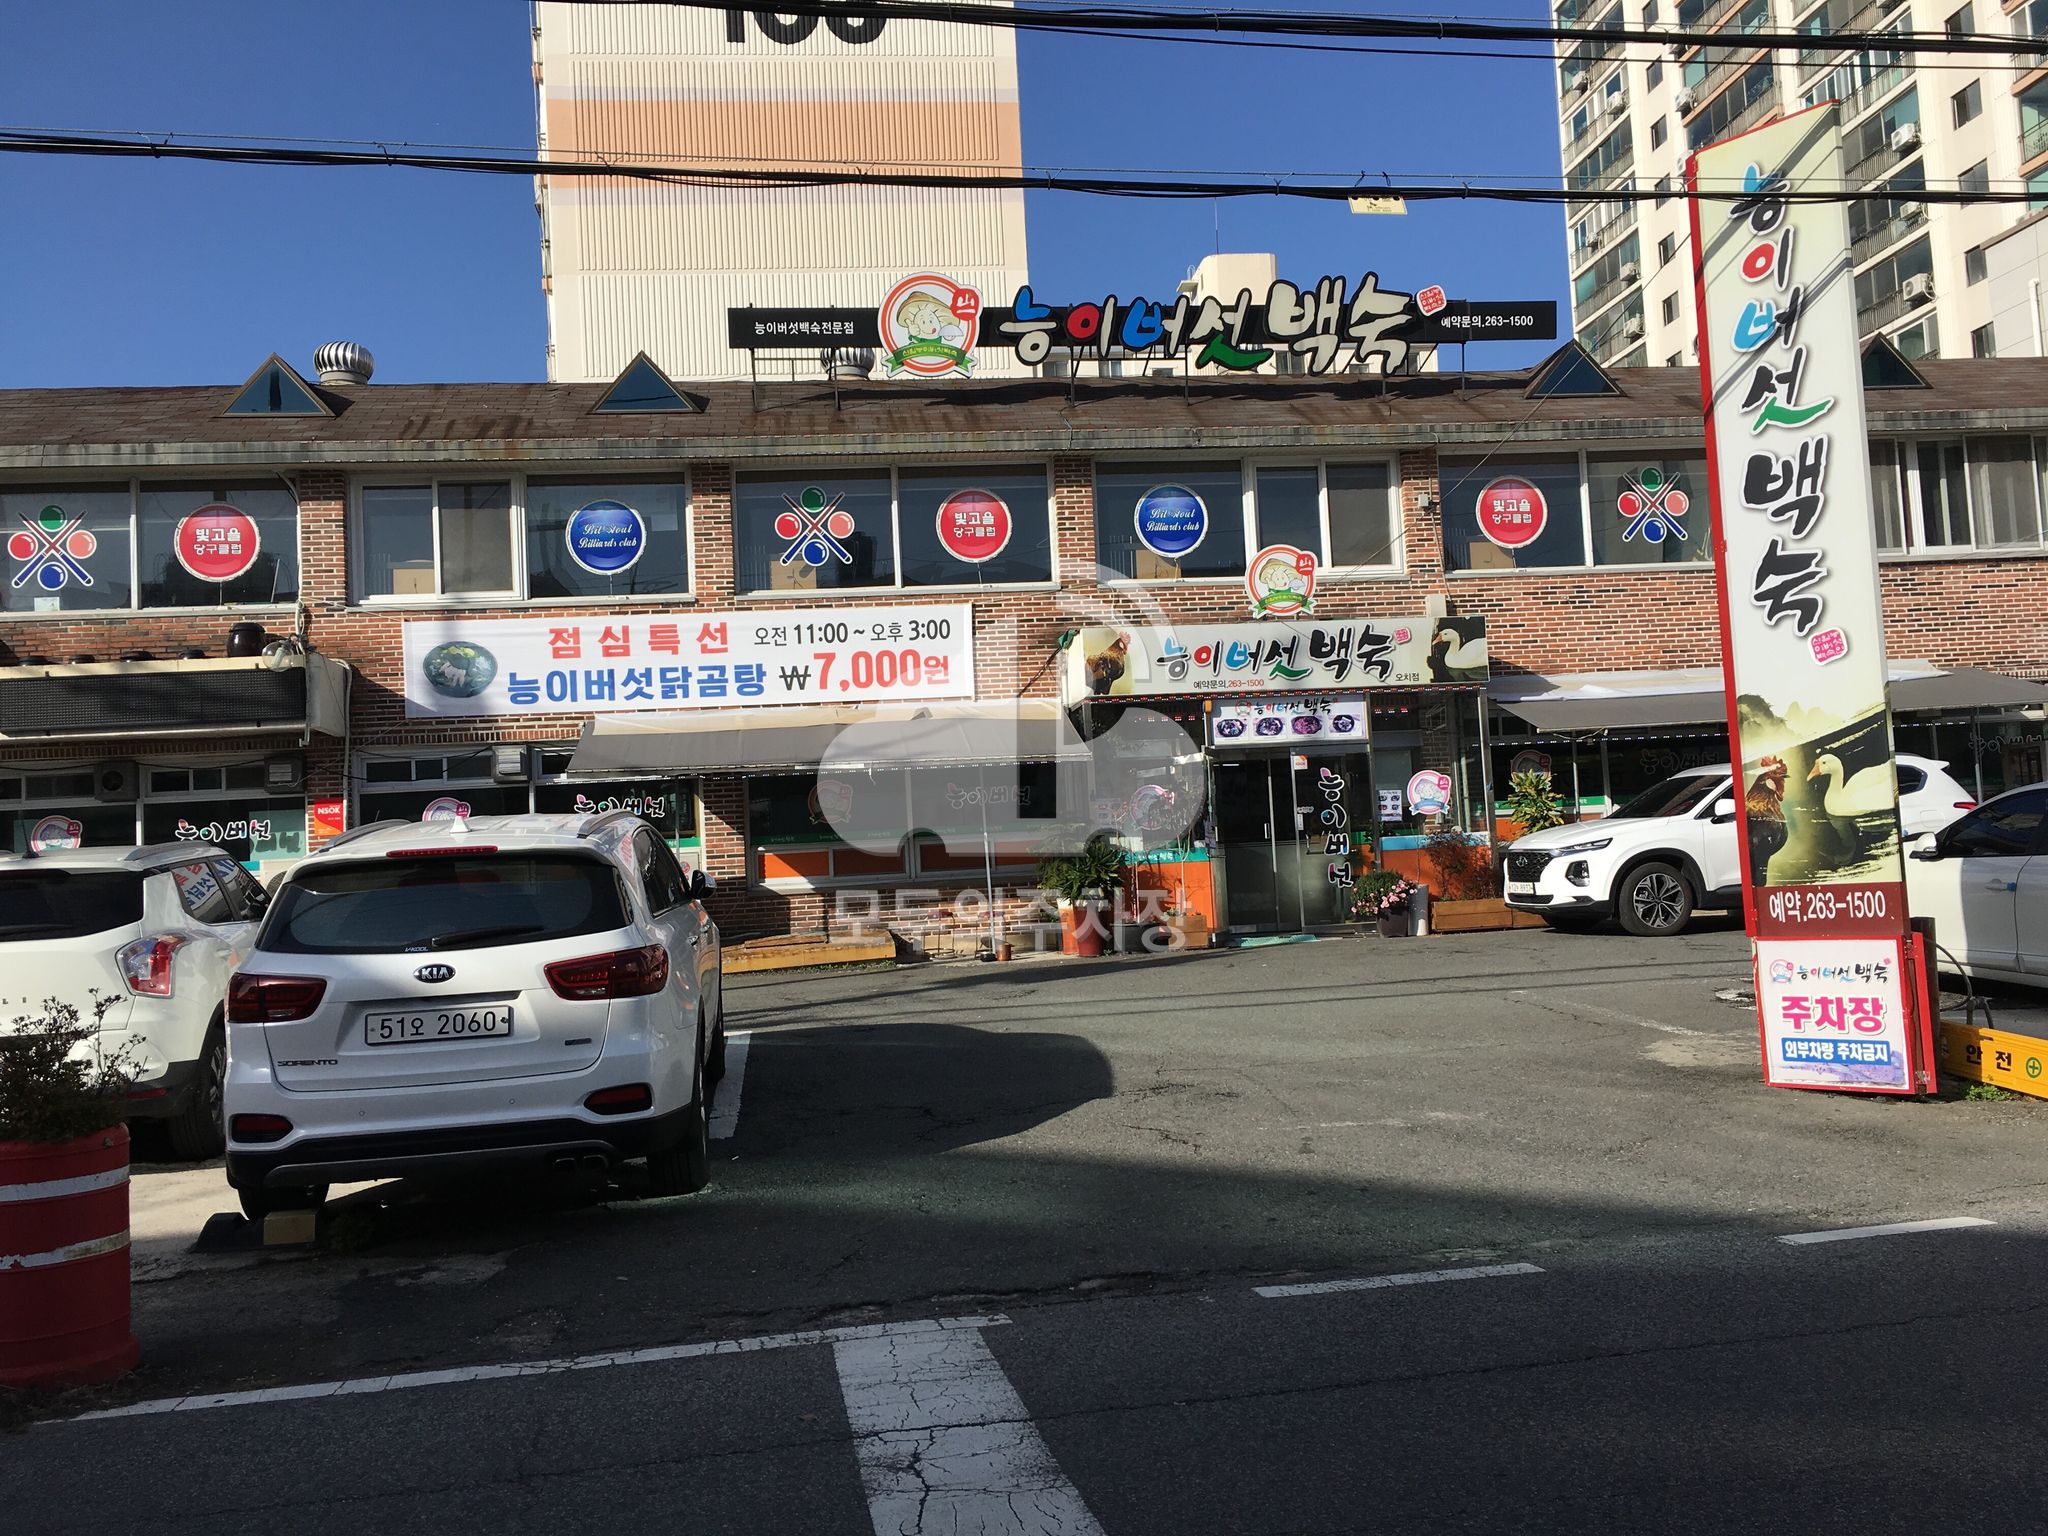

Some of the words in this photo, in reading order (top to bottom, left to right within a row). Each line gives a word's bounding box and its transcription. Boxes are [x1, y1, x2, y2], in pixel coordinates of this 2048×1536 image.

[754, 321, 854, 335] 능이버섯백숙전문점
[998, 271, 1412, 377] 능이버섯백숙
[1731, 164, 1831, 635] 능이버섯백숙
[1493, 498, 1530, 512] 빛고을
[955, 511, 994, 525] 빛고을
[1492, 513, 1532, 524] 당구클럽
[953, 526, 996, 537] 당구클럽
[1146, 521, 1181, 531] Billiards
[1183, 521, 1199, 530] club
[196, 527, 241, 542] 빛고을
[193, 543, 242, 555] 당구클럽
[578, 537, 616, 548] Billiards
[619, 537, 636, 547] club
[754, 624, 787, 646] 오전
[794, 622, 848, 644] 11:00
[870, 621, 904, 643] 오후
[908, 619, 951, 640] 3:00
[1156, 623, 1394, 682] 능이버섯백숙
[507, 663, 766, 705] 능이버섯닭곰탕
[1395, 672, 1420, 682] 오치점
[317, 807, 341, 815] NSOK
[421, 966, 450, 979] KIA
[1796, 961, 1890, 984] 능이버섯백숙
[1781, 995, 1886, 1034] 주차장
[380, 1016, 424, 1039] 51오
[437, 1011, 496, 1035] 2060
[1784, 1041, 1834, 1060] 외부차량
[1837, 1041, 1888, 1062] 주차금지
[277, 1059, 338, 1067] SORENTO
